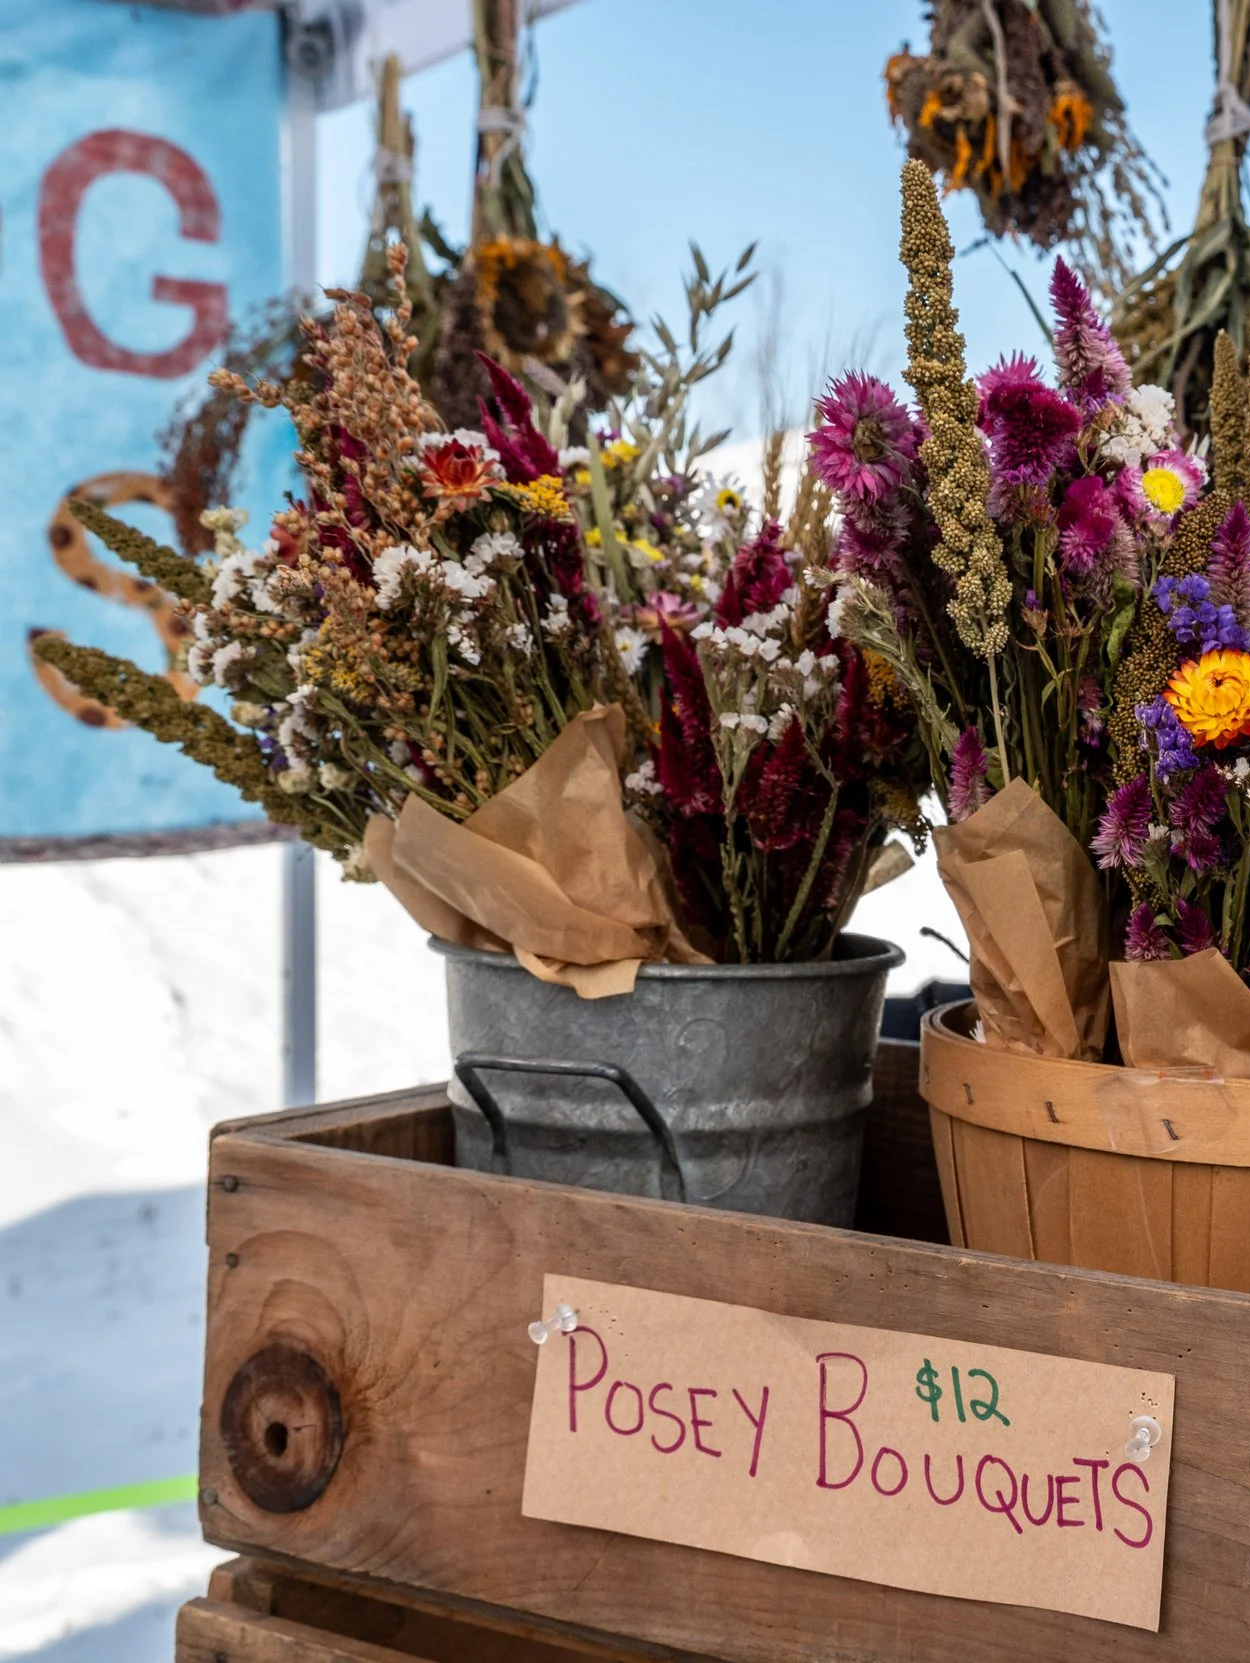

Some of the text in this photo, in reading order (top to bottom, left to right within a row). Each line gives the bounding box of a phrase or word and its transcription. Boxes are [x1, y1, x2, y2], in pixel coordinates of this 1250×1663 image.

[562, 1325, 1153, 1549] POSEY BOUQUETS
[915, 1357, 1011, 1427] $12
